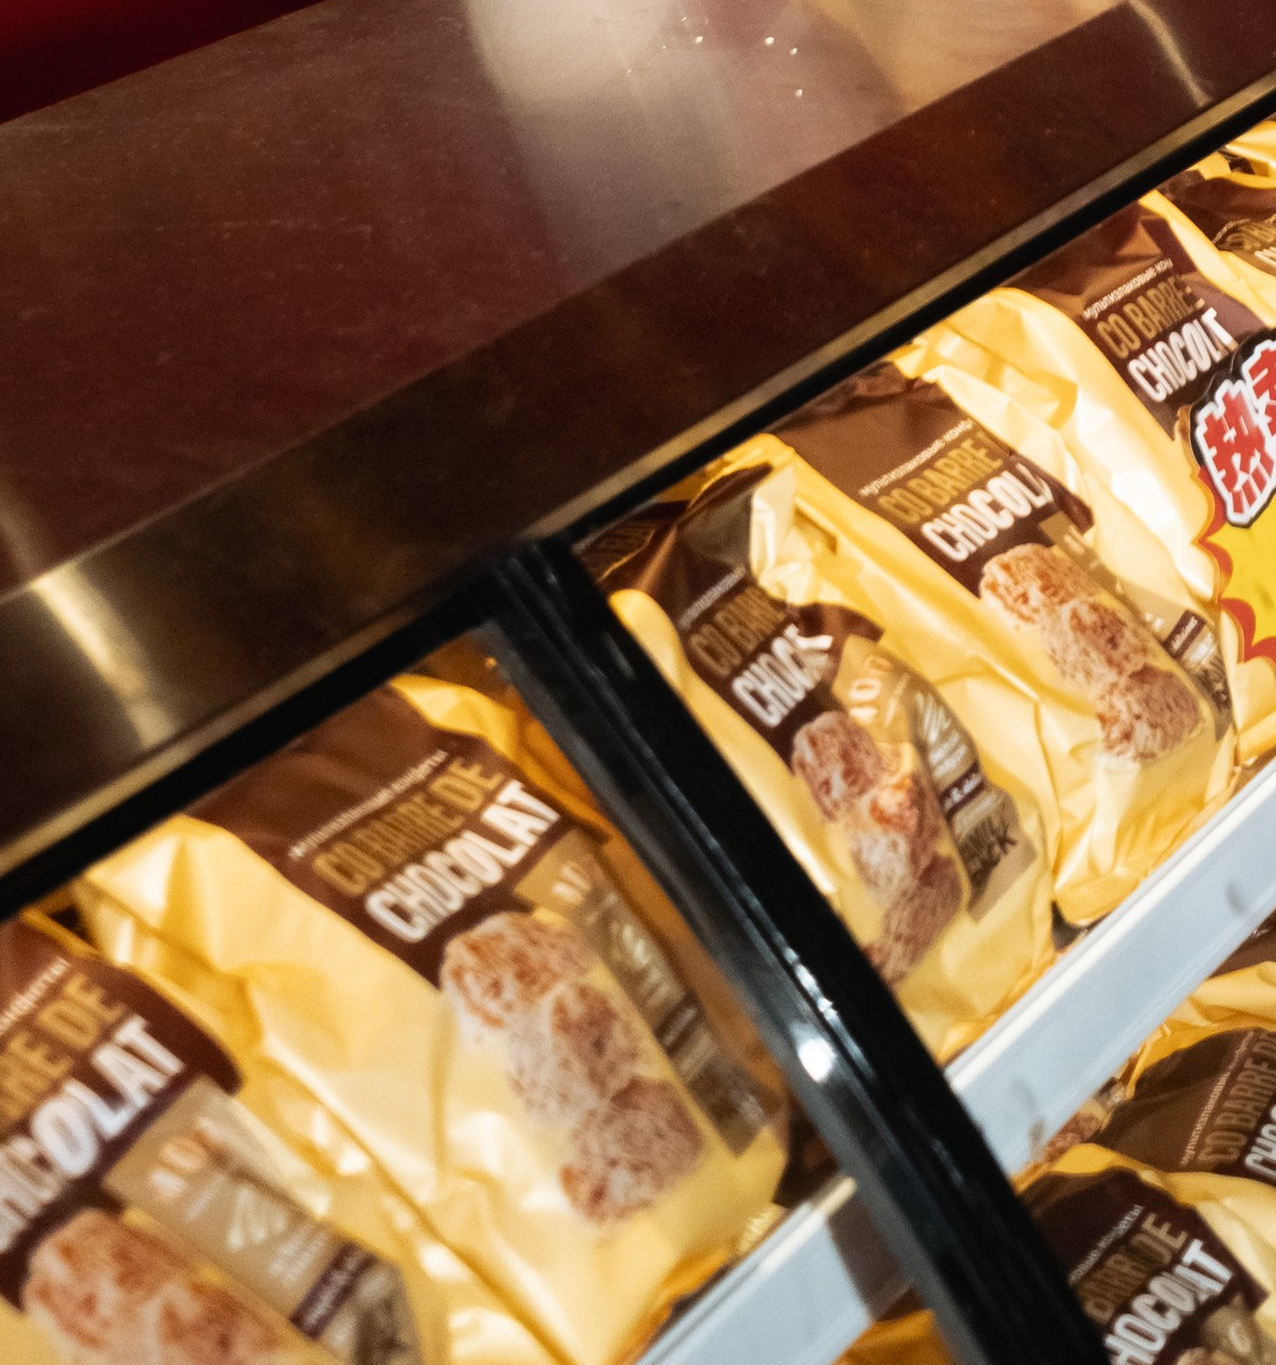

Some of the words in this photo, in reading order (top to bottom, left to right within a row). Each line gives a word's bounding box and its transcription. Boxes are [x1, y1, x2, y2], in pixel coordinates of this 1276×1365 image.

[1097, 312, 1142, 360] CO
[878, 486, 934, 526] CO
[906, 437, 1004, 508] BARRE
[689, 621, 744, 679] CO
[312, 840, 386, 897] CO
[353, 791, 467, 868] BARRE
[429, 756, 504, 813] DE
[363, 777, 561, 944] CHOCOLAT
[38, 971, 129, 1053] DE
[1198, 1129, 1248, 1165] CO
